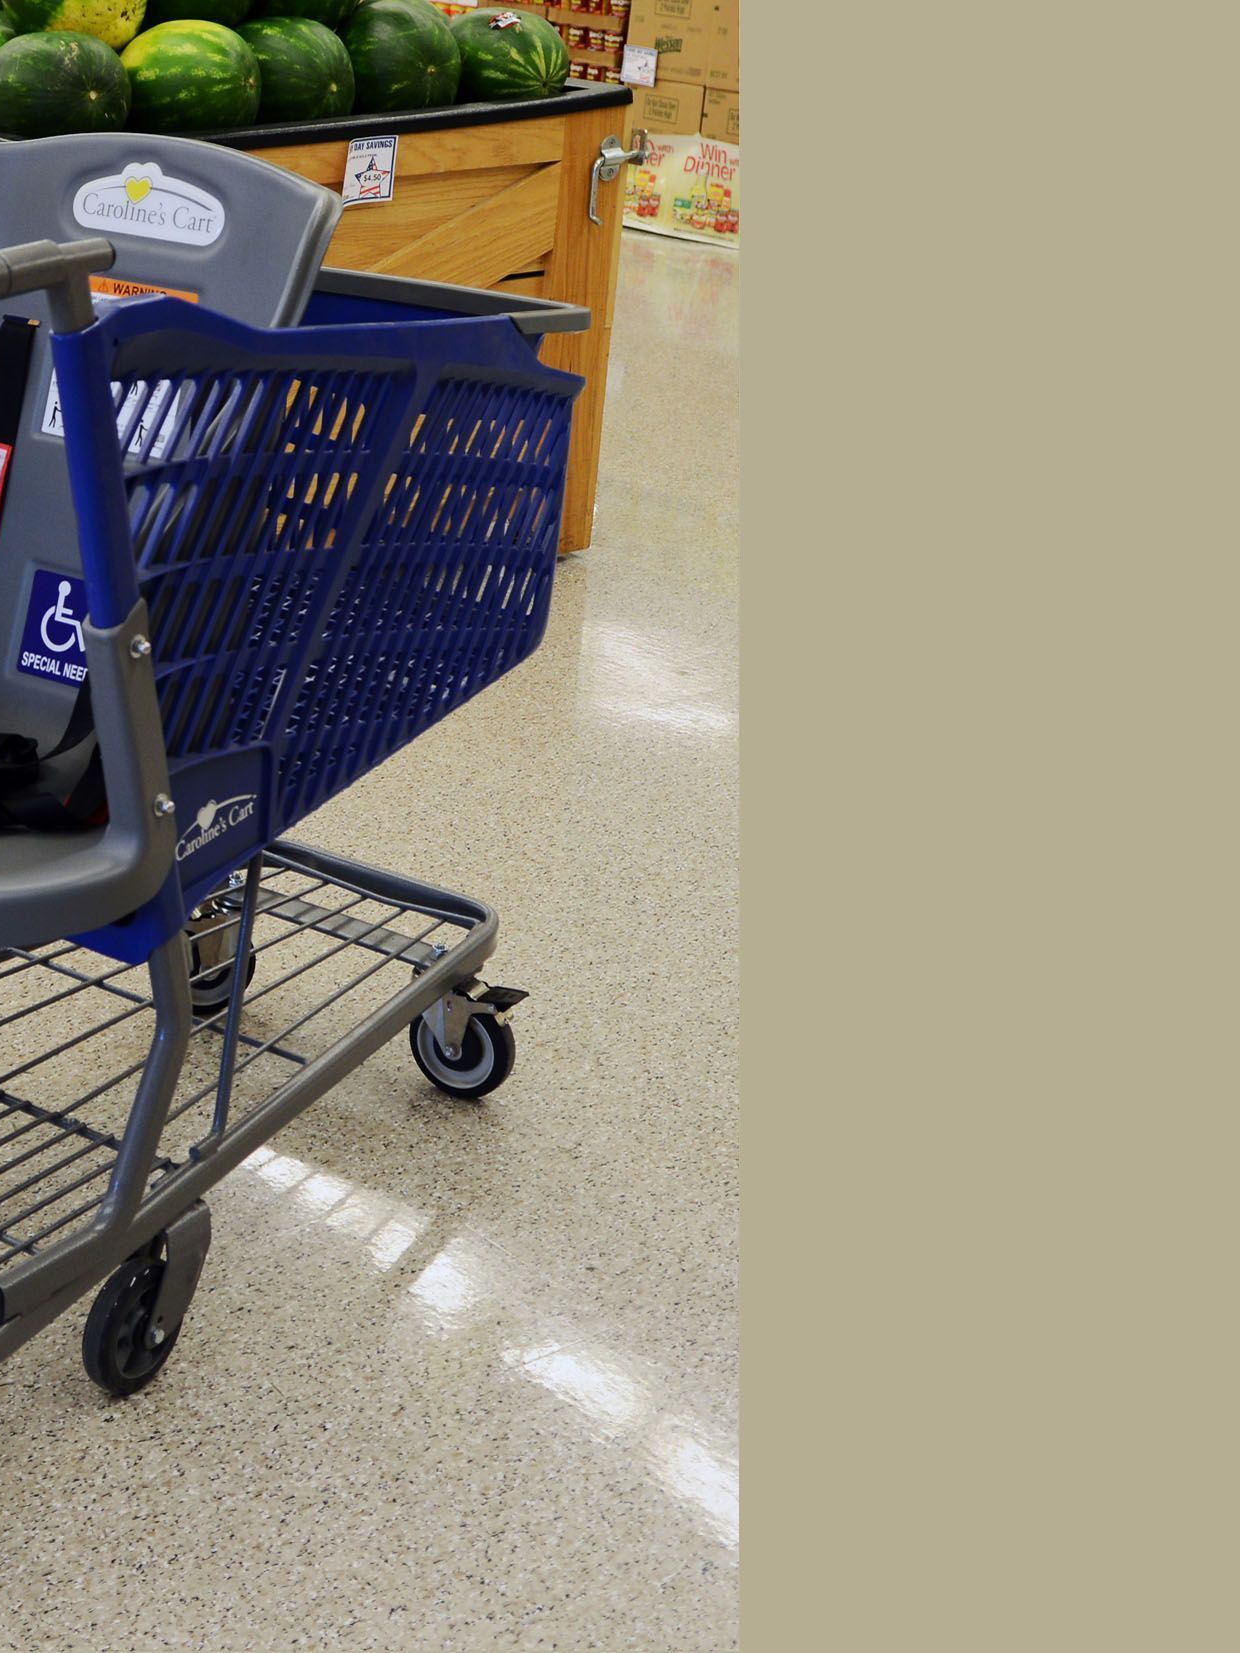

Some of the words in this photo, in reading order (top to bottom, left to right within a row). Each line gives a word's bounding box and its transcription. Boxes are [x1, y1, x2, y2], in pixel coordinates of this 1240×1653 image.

[354, 142, 365, 151] DAY
[366, 140, 392, 150] SAVINGS
[701, 142, 728, 164] Win
[363, 174, 382, 182] $4.50
[684, 155, 736, 181] Dinner
[82, 192, 166, 226] Caroline's
[172, 206, 214, 233] Cart
[21, 651, 61, 676] SPECIAL
[175, 817, 227, 861] Caroline's
[228, 801, 254, 826] Cart
